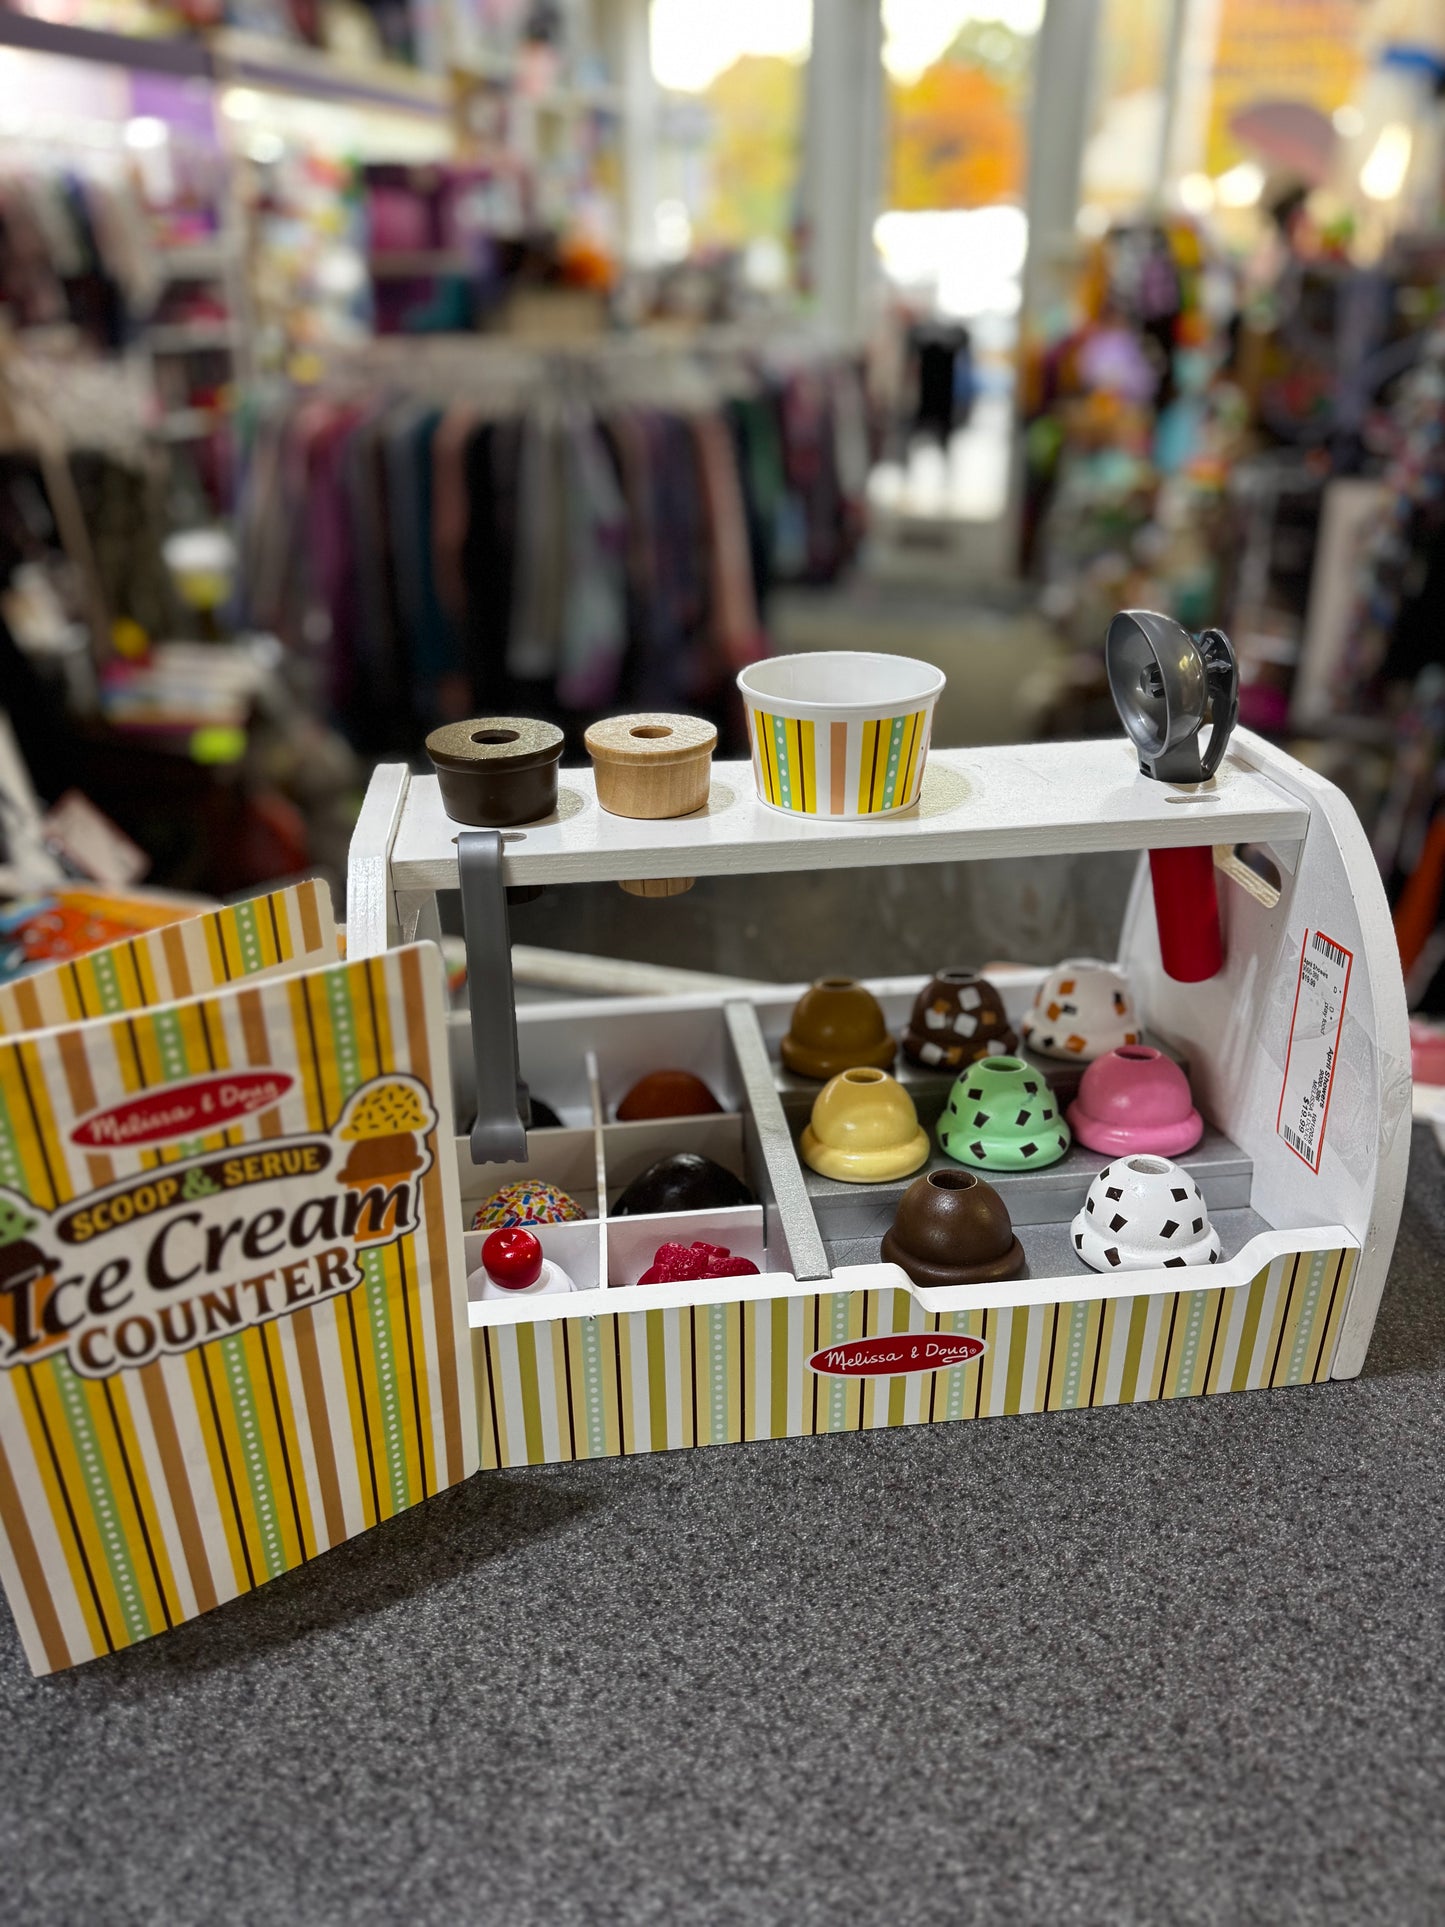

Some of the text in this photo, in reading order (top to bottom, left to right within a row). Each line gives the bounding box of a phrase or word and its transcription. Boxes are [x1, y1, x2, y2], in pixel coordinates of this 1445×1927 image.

[1320, 1002, 1329, 1036] play food
[1308, 1080, 1317, 1112] MELISSA
[1319, 1046, 1334, 1109] April Showers
[87, 1104, 196, 1144] Melissa
[219, 1080, 279, 1110] Doug
[1298, 1096, 1309, 1133] $19.99
[71, 1146, 322, 1243] SCOOP & SERVE
[2, 1182, 412, 1360] Ice Cream
[77, 1246, 355, 1371] COUNTER
[824, 1350, 904, 1371] Melissa
[910, 1346, 920, 1359] &
